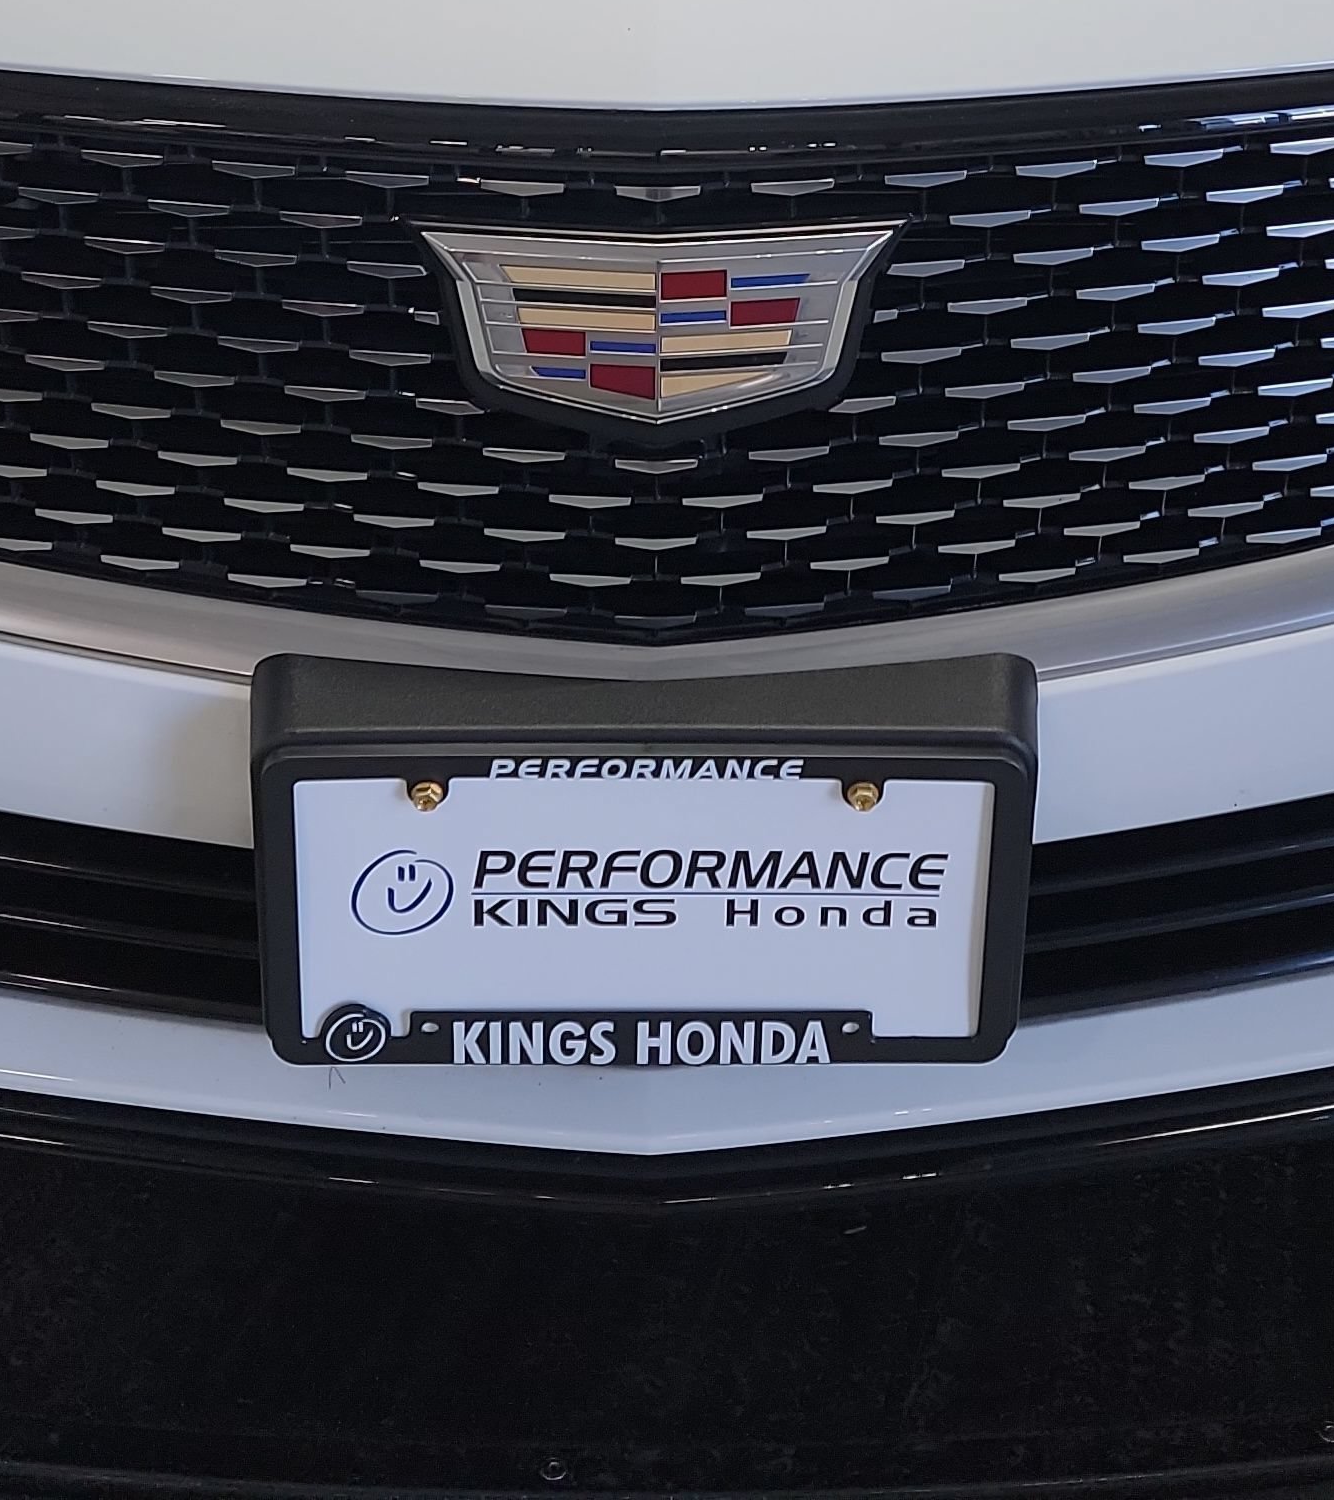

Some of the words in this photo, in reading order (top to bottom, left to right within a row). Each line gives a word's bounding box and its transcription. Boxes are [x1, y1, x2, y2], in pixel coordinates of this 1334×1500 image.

[488, 757, 805, 781] PERFORMANCE
[472, 849, 949, 891] PERFORMANCE
[472, 898, 677, 928] KINGS
[724, 899, 938, 929] Honda
[451, 1020, 617, 1066] KINGS
[635, 1019, 832, 1065] HONDA
